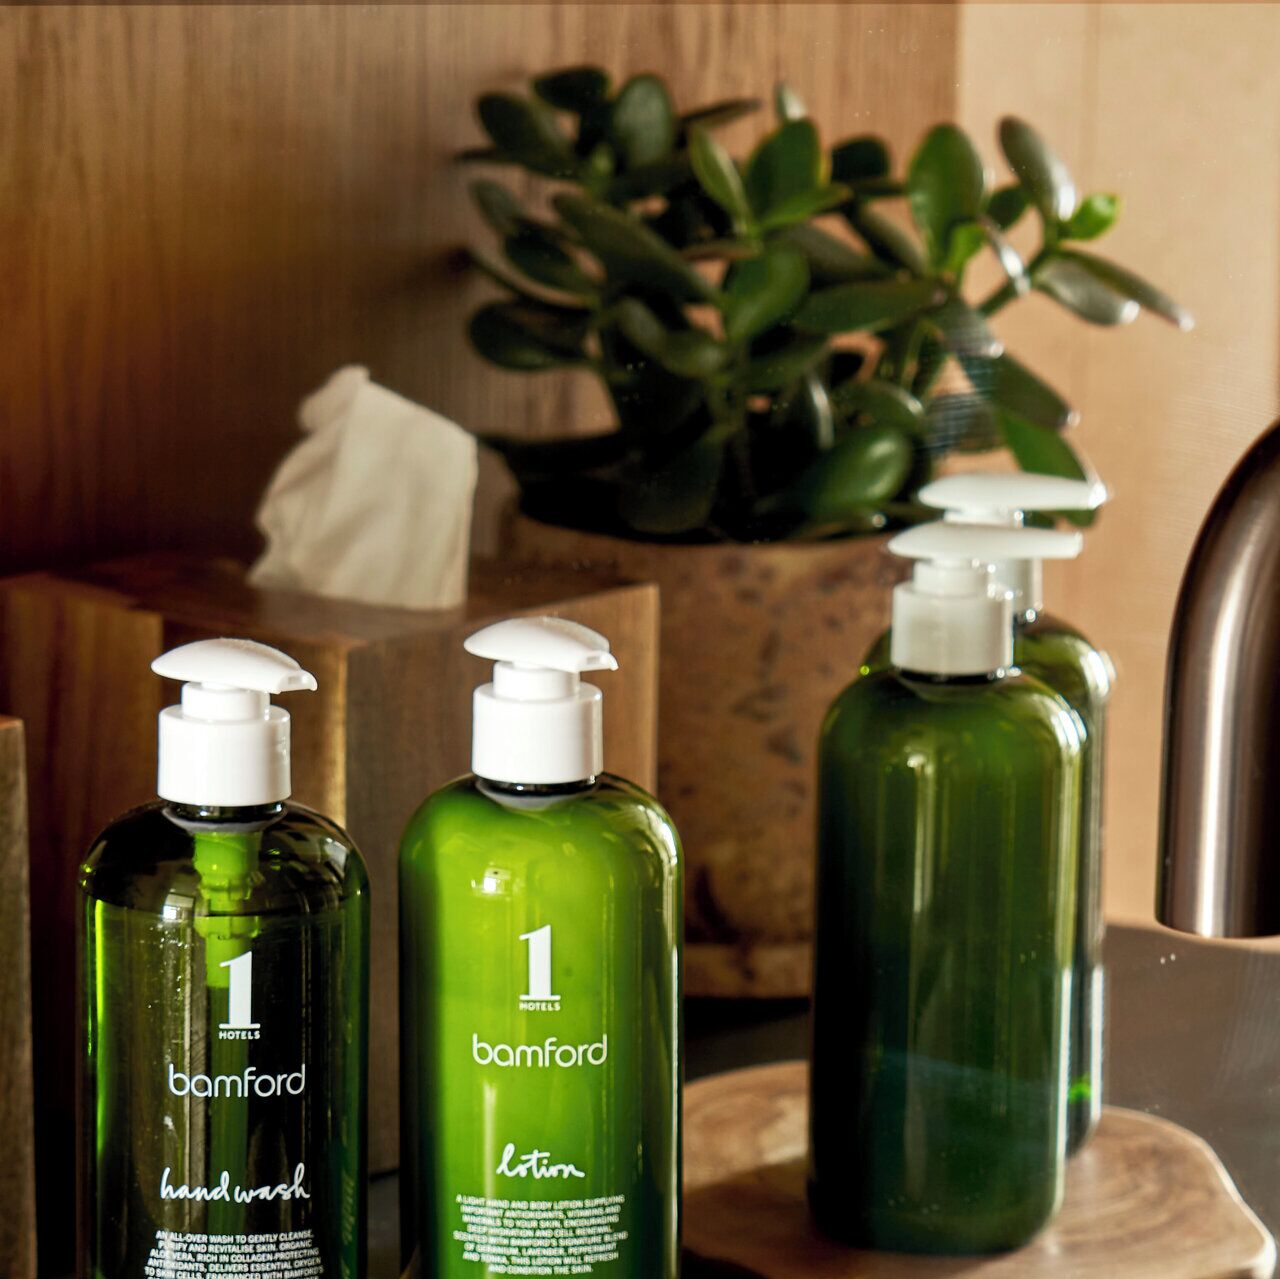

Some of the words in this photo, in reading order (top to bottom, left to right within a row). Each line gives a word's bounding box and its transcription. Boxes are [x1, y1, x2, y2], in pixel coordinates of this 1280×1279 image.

[519, 925, 561, 1000] 1
[219, 950, 261, 1029] 1
[520, 1002, 561, 1011] HOTELS
[218, 1030, 260, 1040] HOTELS
[473, 1033, 607, 1067] bamford
[168, 1063, 305, 1098] bamford
[496, 1143, 585, 1179] lotion
[511, 1201, 528, 1210] AND
[530, 1201, 552, 1210] BODY
[553, 1200, 583, 1209] LOTION
[567, 1207, 604, 1218] VITAMINS
[462, 1214, 501, 1226] MINERALS
[503, 1218, 514, 1227] TO
[516, 1219, 538, 1228] YOUR
[564, 1214, 619, 1227] ENCOURAGING
[155, 1230, 168, 1240] AN
[170, 1232, 208, 1243] ALL-OVER
[209, 1235, 233, 1244] WASH
[235, 1235, 247, 1244] TO
[248, 1233, 278, 1243] GENTLY
[467, 1224, 487, 1234] DEEP
[535, 1229, 553, 1237] AND
[554, 1228, 573, 1237] CELL
[488, 1236, 509, 1245] WITH
[559, 1235, 602, 1246] SIGNATURE
[604, 1230, 628, 1242] BLEND
[188, 1244, 207, 1253] AND
[208, 1245, 254, 1253] REVITALISE
[279, 1239, 312, 1250] ORGANIC
[464, 1242, 475, 1251] OF
[568, 1242, 616, 1254] PEPPERMINT
[196, 1254, 218, 1263] RICH
[219, 1254, 229, 1263] IN
[230, 1248, 319, 1263] COLLAGEN-PROTECTING
[463, 1251, 480, 1261] AND
[511, 1256, 530, 1265] THIS
[532, 1256, 562, 1265] LOTION
[563, 1255, 582, 1265] WILL
[583, 1252, 618, 1263] REFRESH
[208, 1263, 249, 1272] DELIVERS
[250, 1260, 292, 1271] ESSENTIAL
[294, 1256, 321, 1268] OXYGEN
[507, 1265, 552, 1275] CONDITION
[554, 1266, 570, 1274] THE
[144, 1266, 155, 1276] TO
[156, 1268, 175, 1279] SKIN
[262, 1269, 282, 1279] WITH
